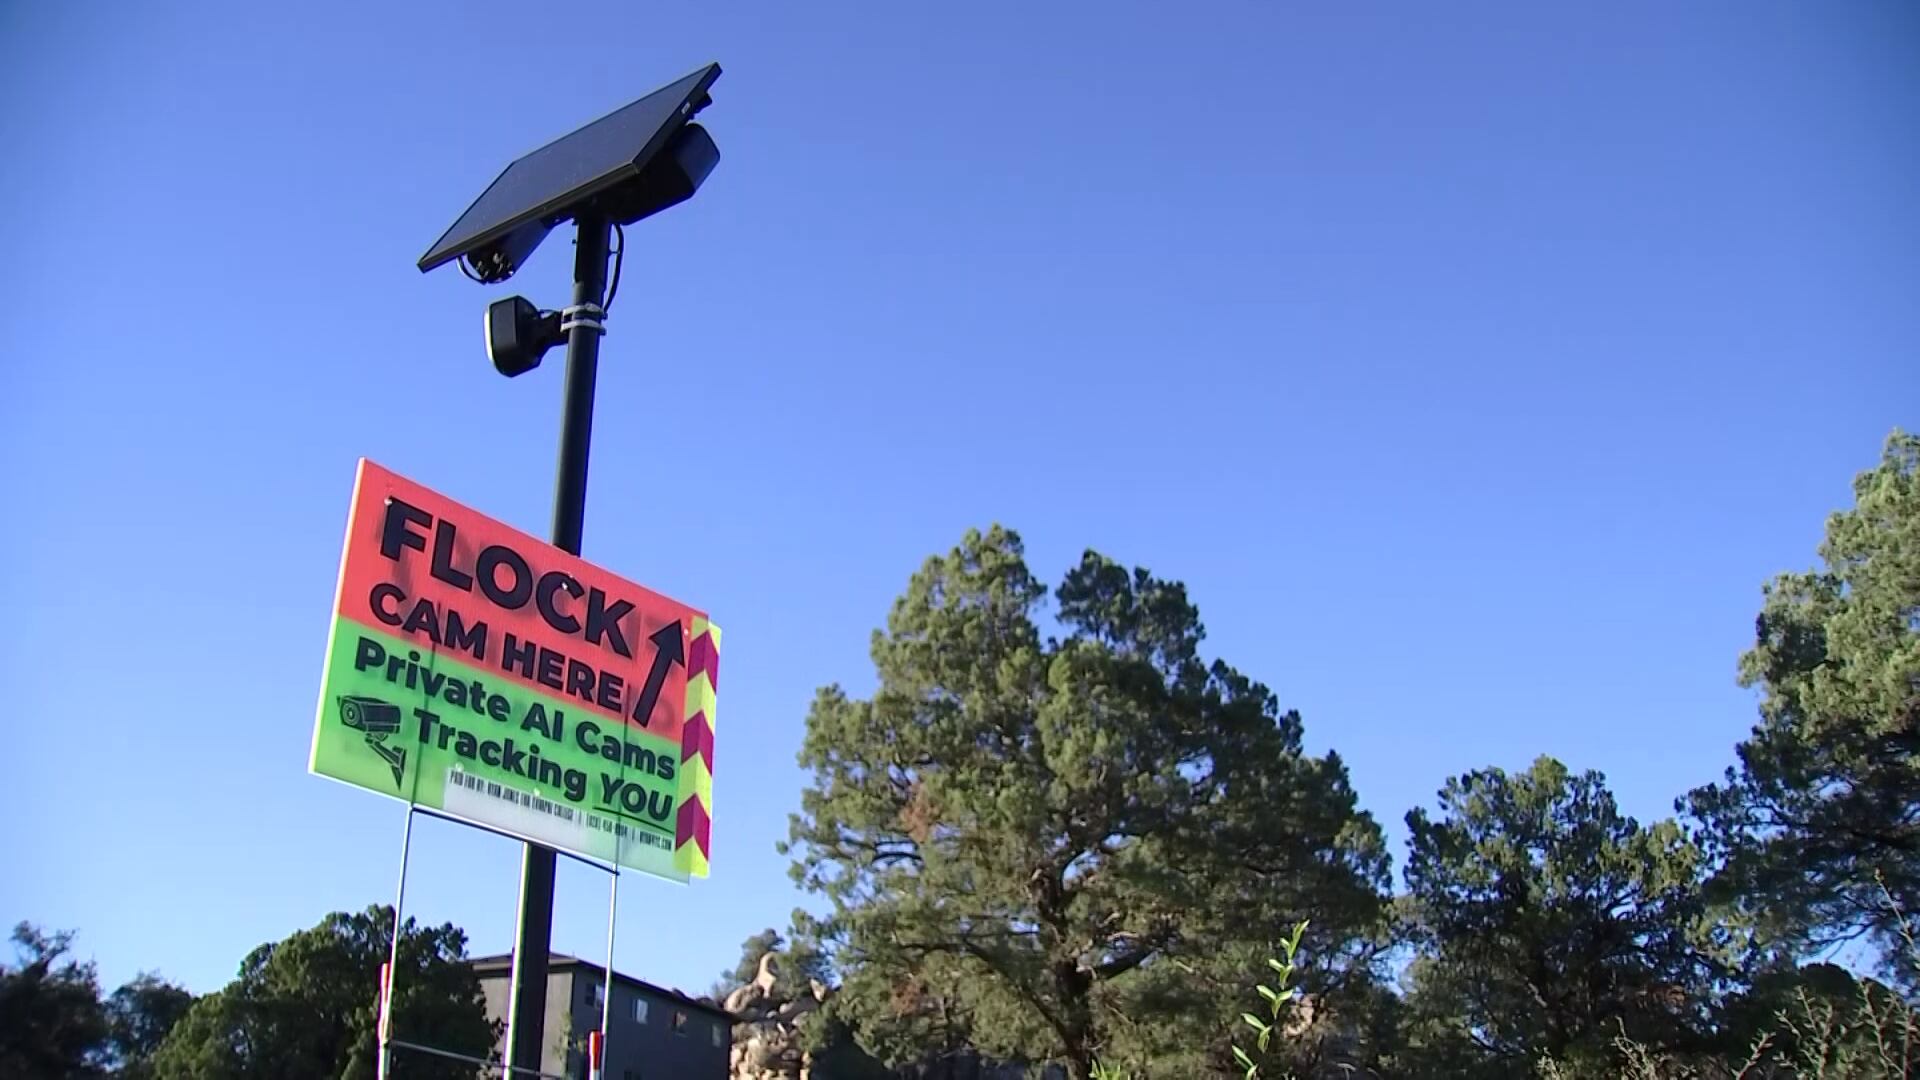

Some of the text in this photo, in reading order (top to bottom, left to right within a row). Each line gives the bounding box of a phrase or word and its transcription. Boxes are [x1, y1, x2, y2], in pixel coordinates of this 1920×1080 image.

[380, 496, 635, 659] FLOCK
[354, 636, 675, 780] Private AI Cams
[369, 583, 624, 713] CAM HERE
[413, 709, 674, 822] Tracking YOU
